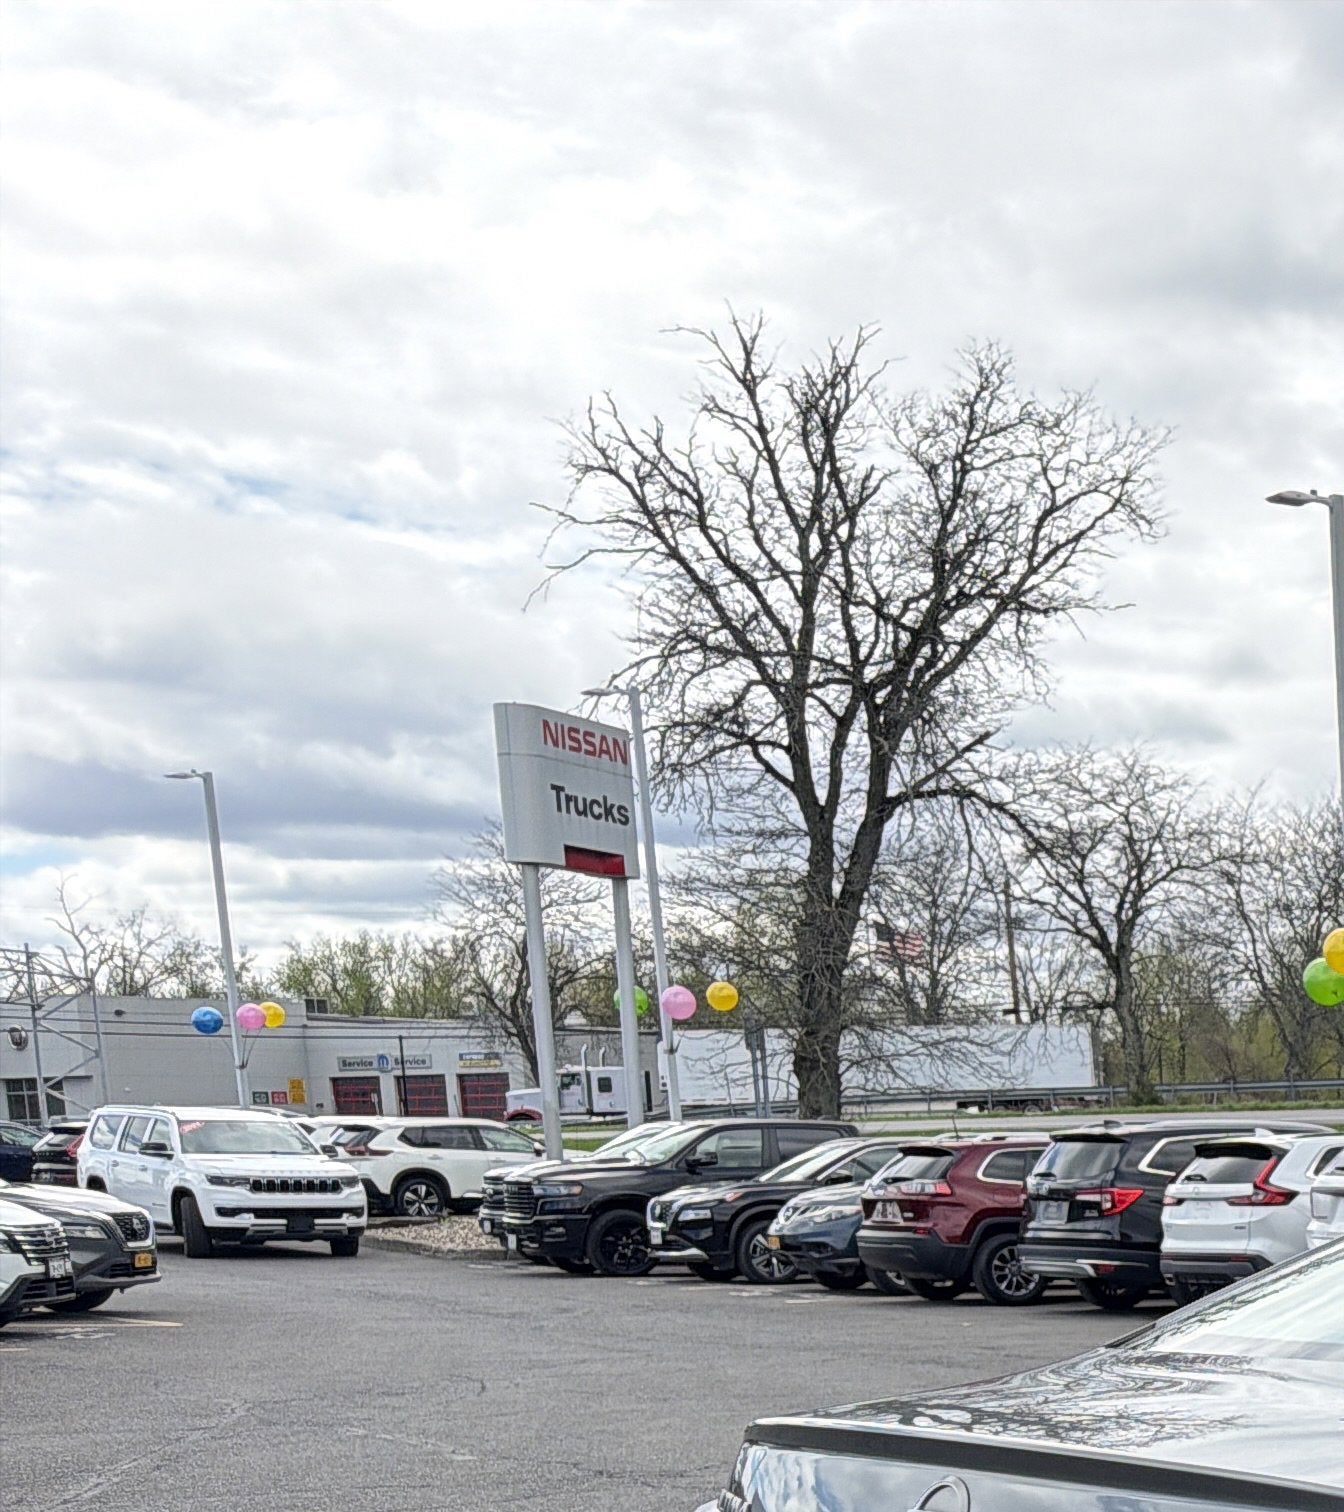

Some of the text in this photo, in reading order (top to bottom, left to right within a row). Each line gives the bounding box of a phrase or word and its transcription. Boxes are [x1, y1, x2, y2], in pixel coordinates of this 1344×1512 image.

[542, 718, 628, 766] NISSAN
[550, 783, 630, 828] Trucks
[342, 1056, 427, 1068] Service Srvice
